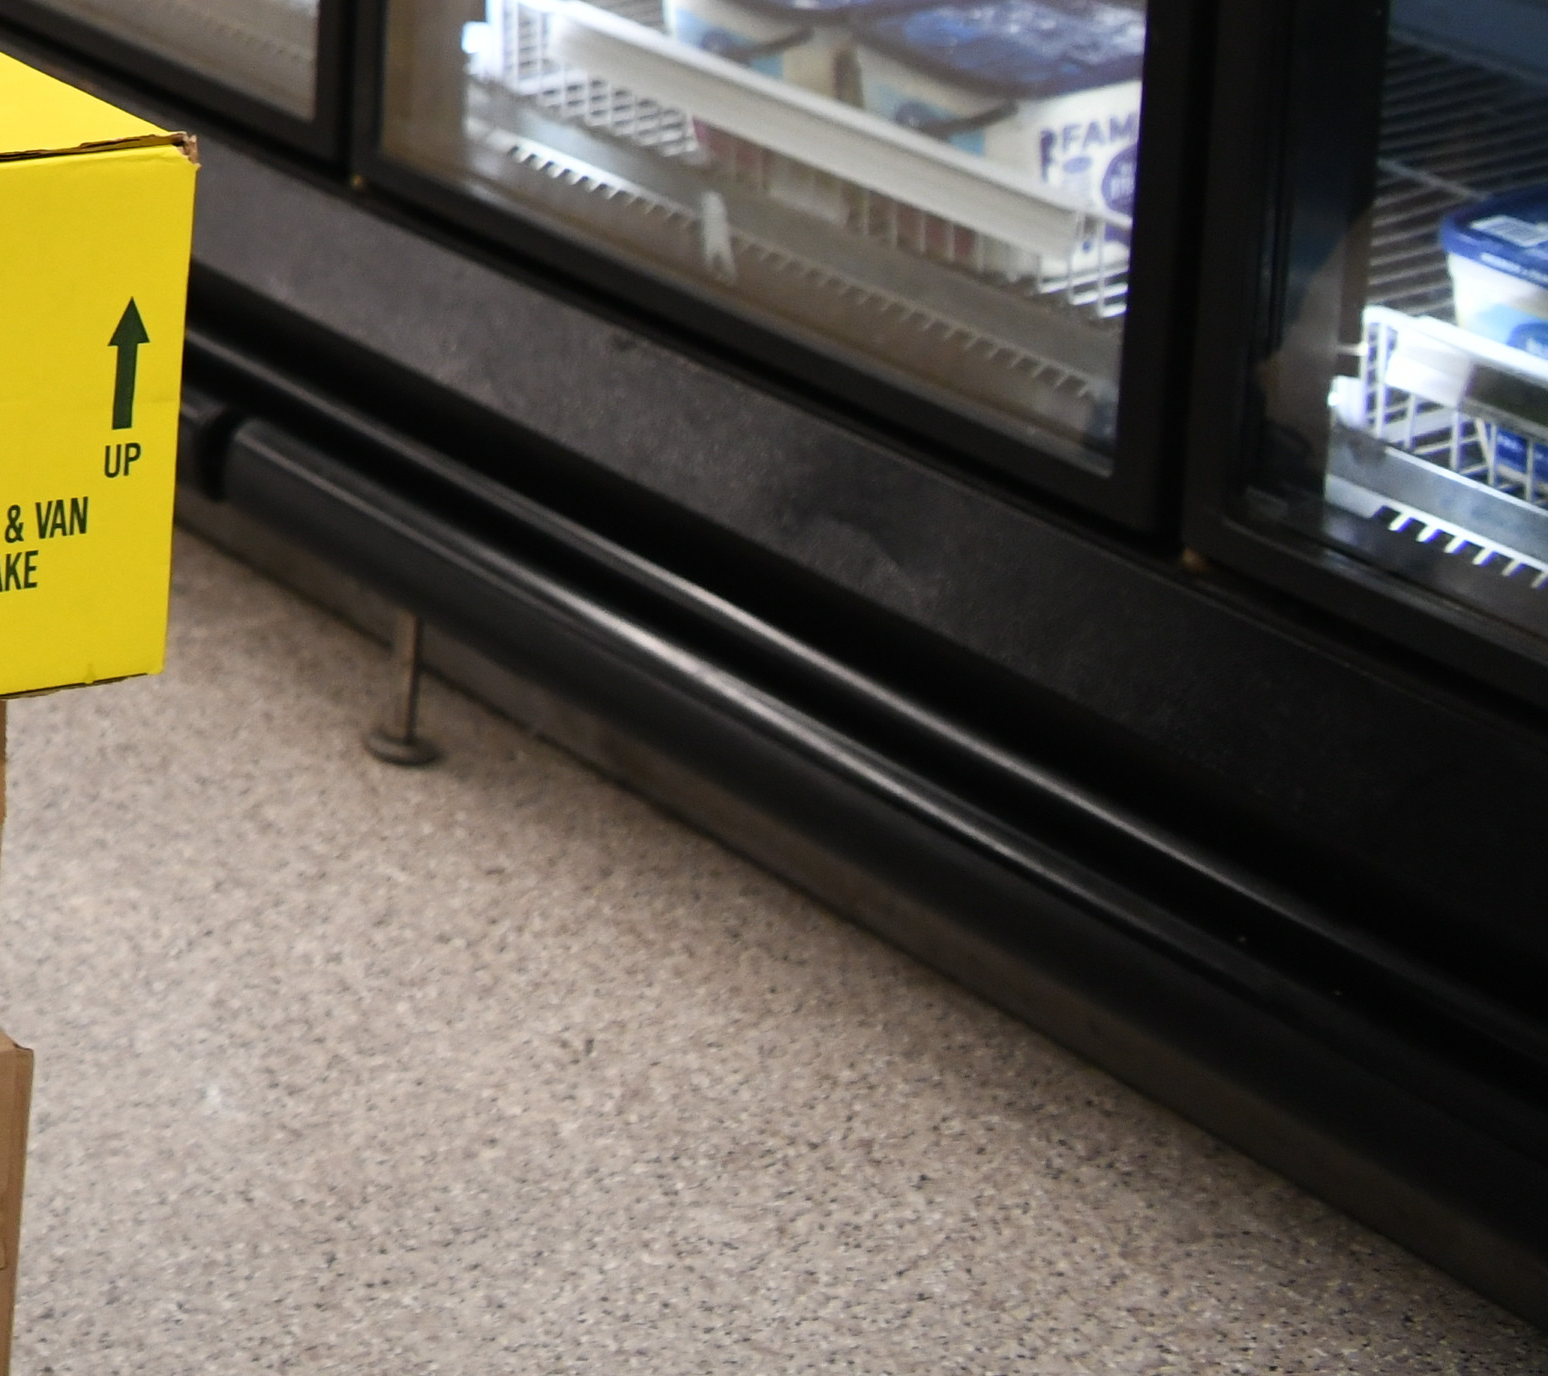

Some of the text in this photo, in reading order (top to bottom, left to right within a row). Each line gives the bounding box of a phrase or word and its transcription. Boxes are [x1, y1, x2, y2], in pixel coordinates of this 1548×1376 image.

[1062, 113, 1137, 153] FAM
[104, 442, 141, 478] UP
[5, 505, 24, 543] &
[35, 496, 89, 539] VAN
